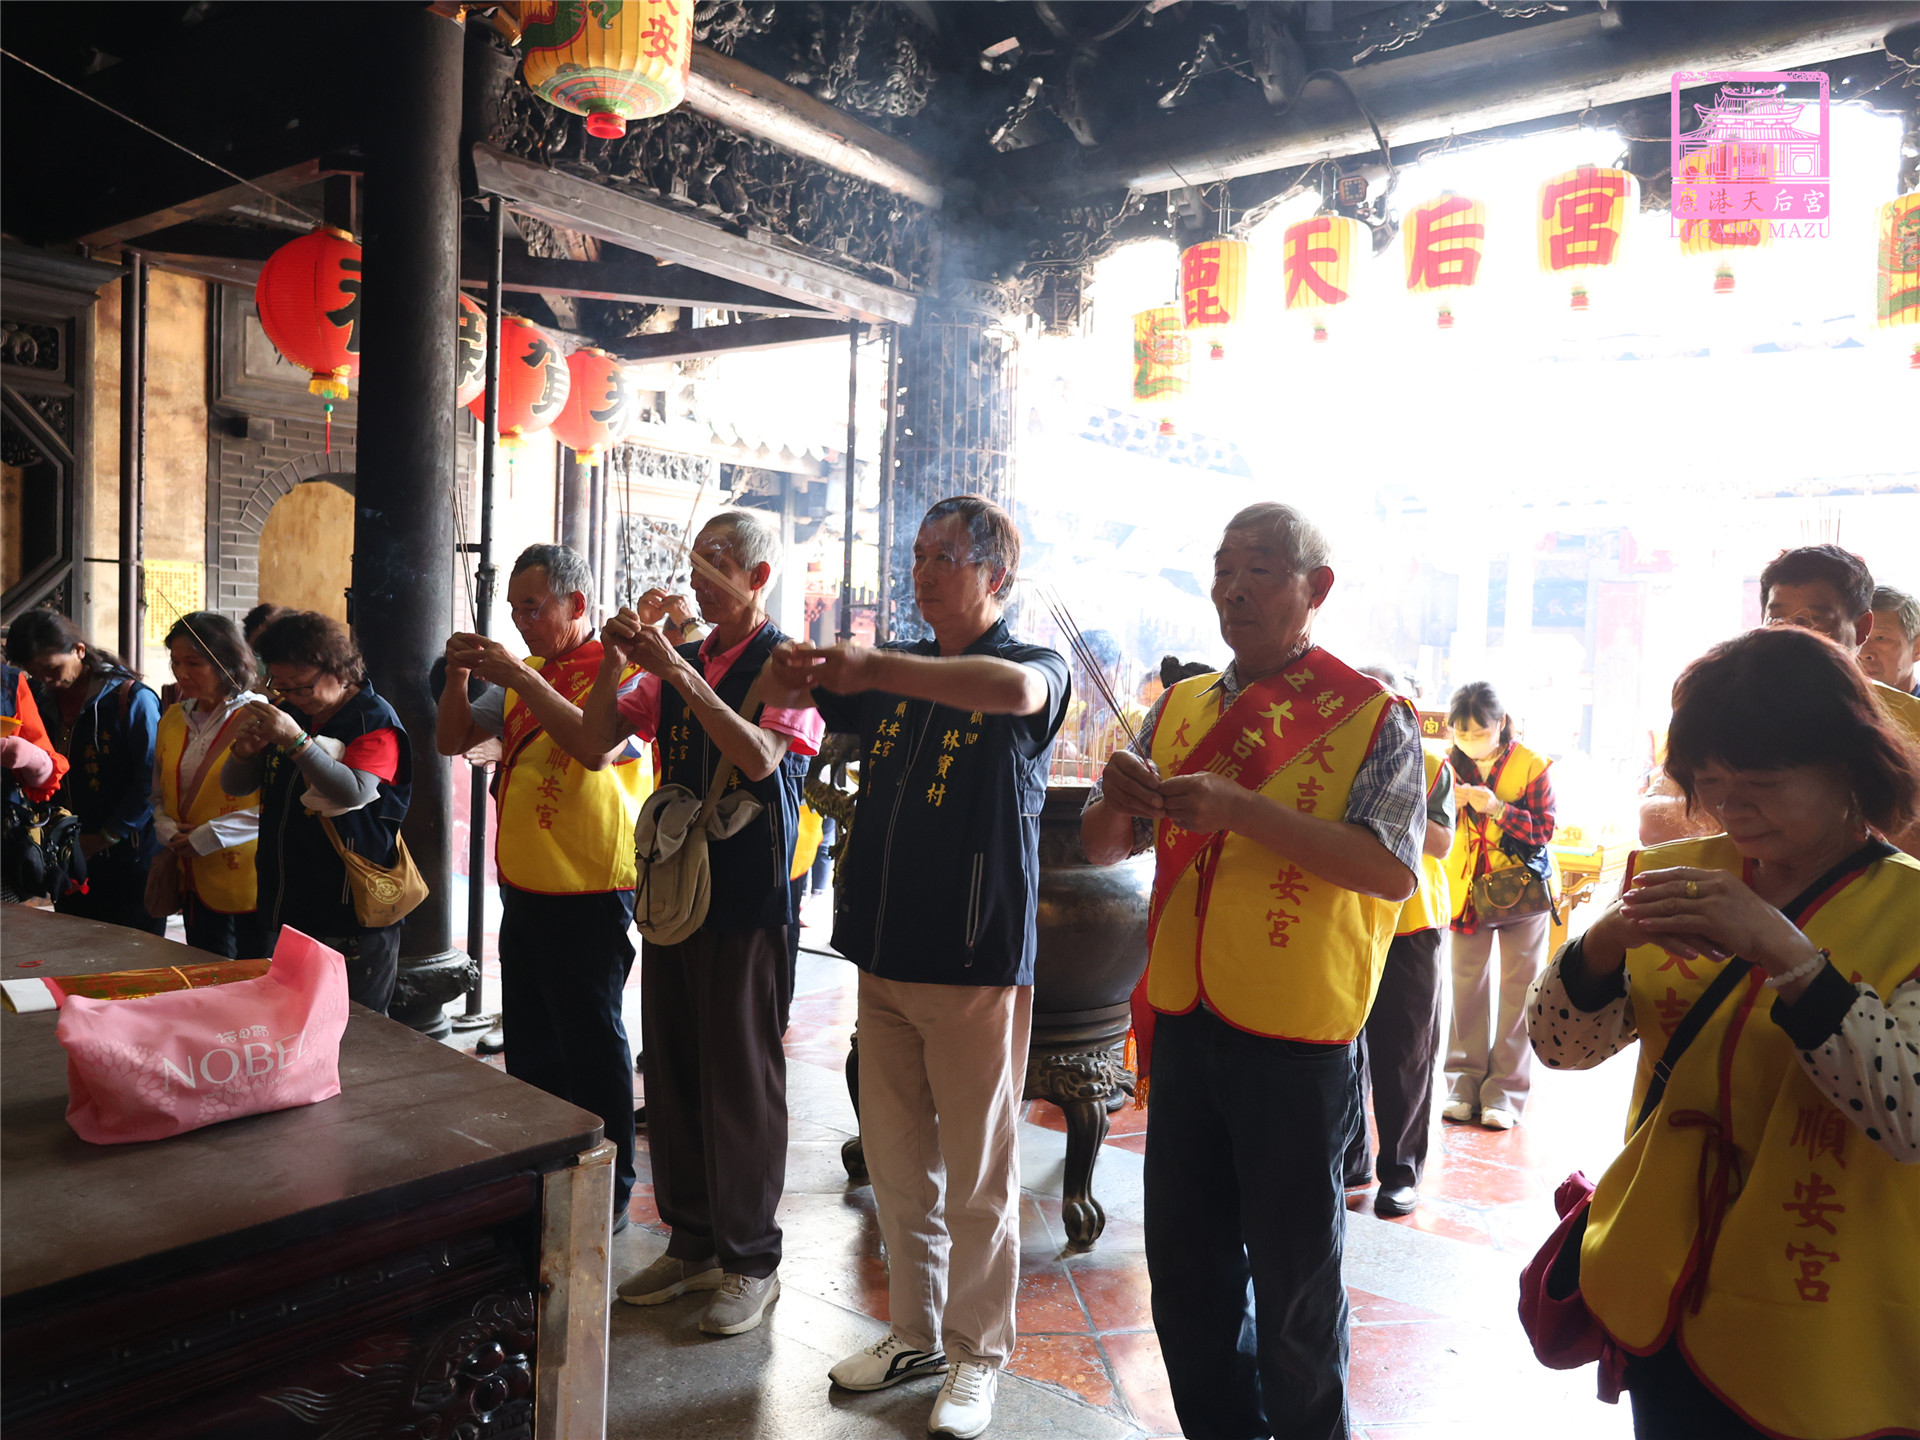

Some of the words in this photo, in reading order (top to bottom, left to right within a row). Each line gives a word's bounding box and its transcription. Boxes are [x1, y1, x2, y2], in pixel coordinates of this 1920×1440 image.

[641, 0, 679, 66] 安
[1283, 217, 1350, 311] 天
[1406, 196, 1485, 289] 后
[1541, 167, 1631, 271] 宮
[1283, 668, 1345, 718] 五結
